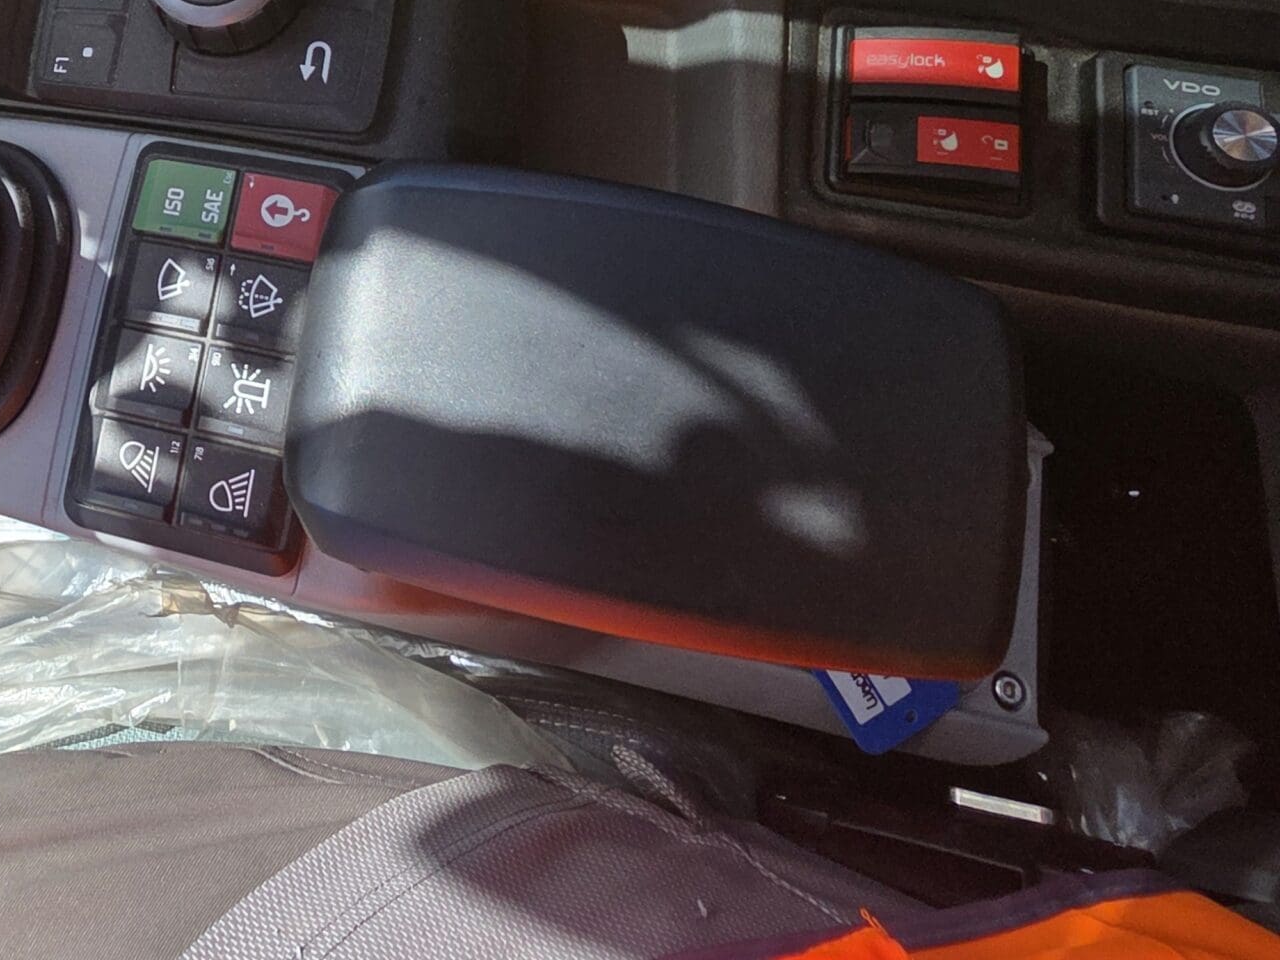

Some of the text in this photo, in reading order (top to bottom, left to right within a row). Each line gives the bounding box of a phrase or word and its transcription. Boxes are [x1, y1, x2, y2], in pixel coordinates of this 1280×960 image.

[53, 57, 69, 73] F1
[866, 53, 946, 69] easylock
[1163, 78, 1221, 96] VDO
[163, 187, 184, 216] ISO
[201, 189, 224, 224] SAE
